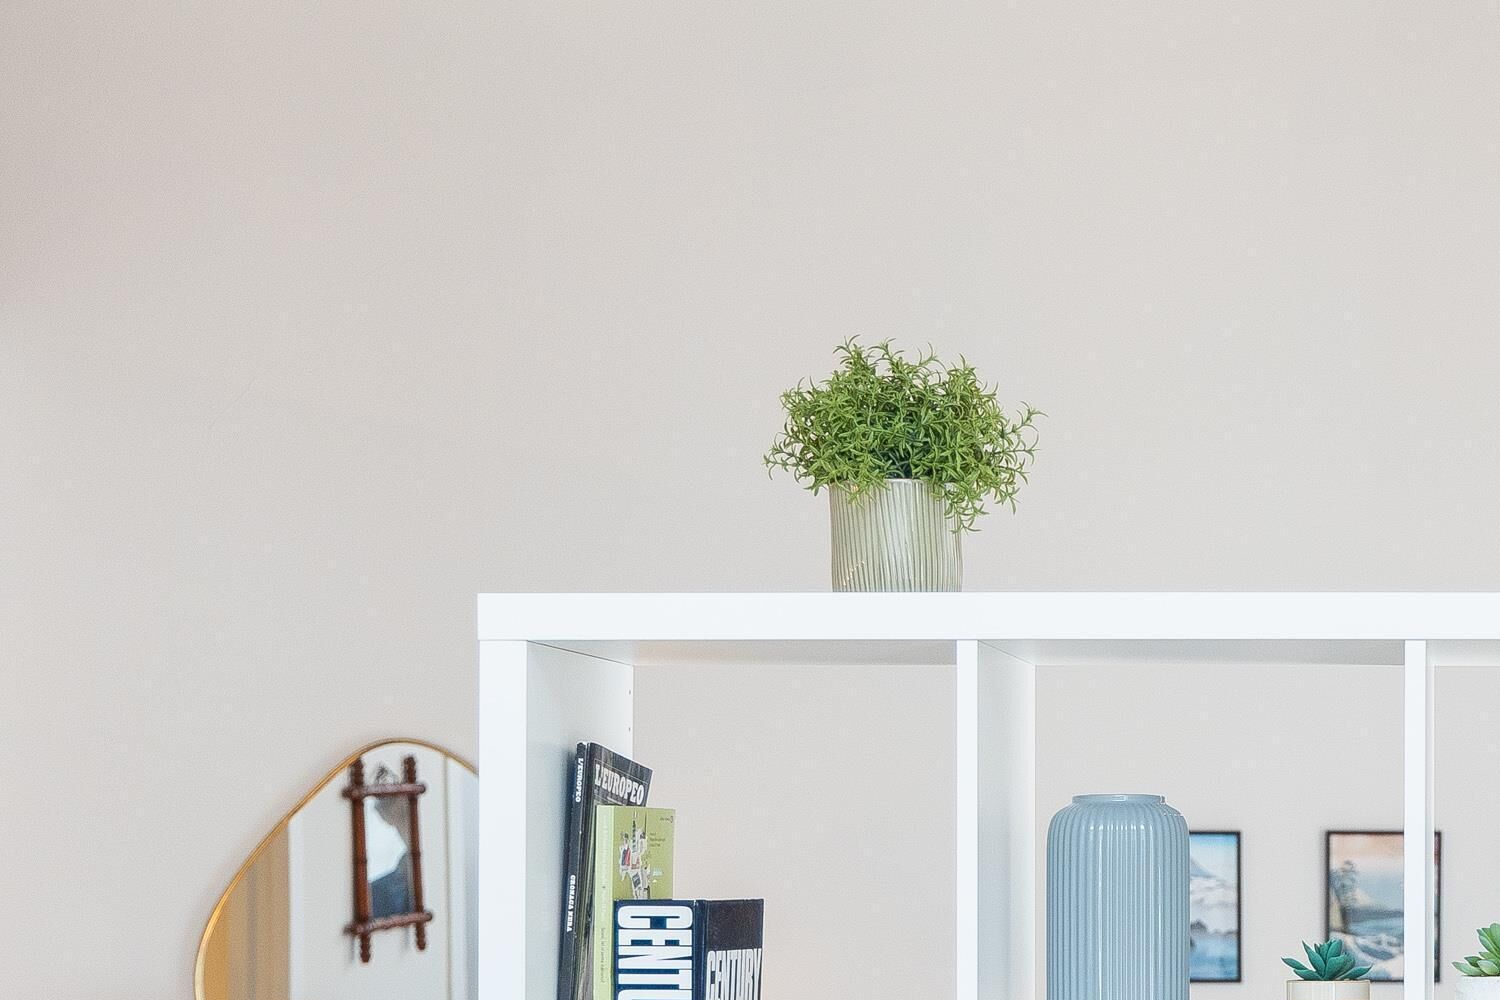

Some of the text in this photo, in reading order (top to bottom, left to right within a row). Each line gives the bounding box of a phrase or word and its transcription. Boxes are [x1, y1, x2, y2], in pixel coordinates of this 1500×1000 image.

[575, 758, 584, 802] L'EUROPEO
[594, 764, 644, 805] L'EUROPEO
[568, 875, 576, 909] CRONACA
